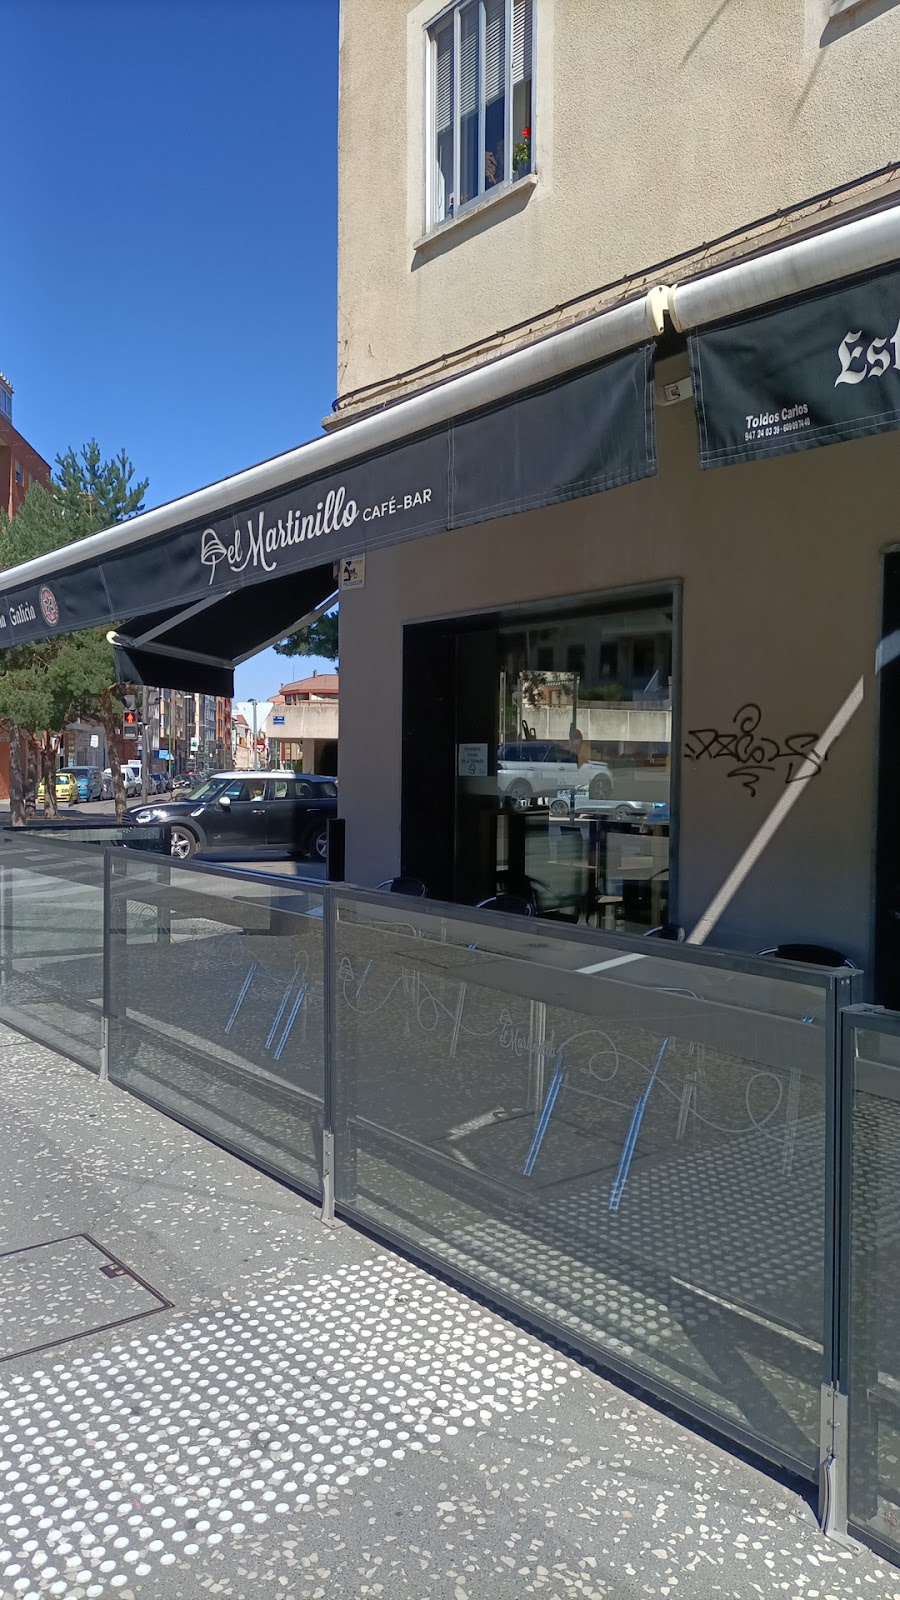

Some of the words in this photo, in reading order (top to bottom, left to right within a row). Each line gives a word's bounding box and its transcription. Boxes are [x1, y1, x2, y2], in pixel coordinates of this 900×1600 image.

[746, 412, 780, 429] Toldos
[781, 403, 809, 420] Carlos
[744, 430, 756, 441] 947
[757, 429, 765, 439] 24
[362, 488, 433, 523] CAFÉ-BAR
[229, 486, 360, 572] Martinillo
[227, 529, 243, 564] el
[9, 601, 37, 626] Galicia
